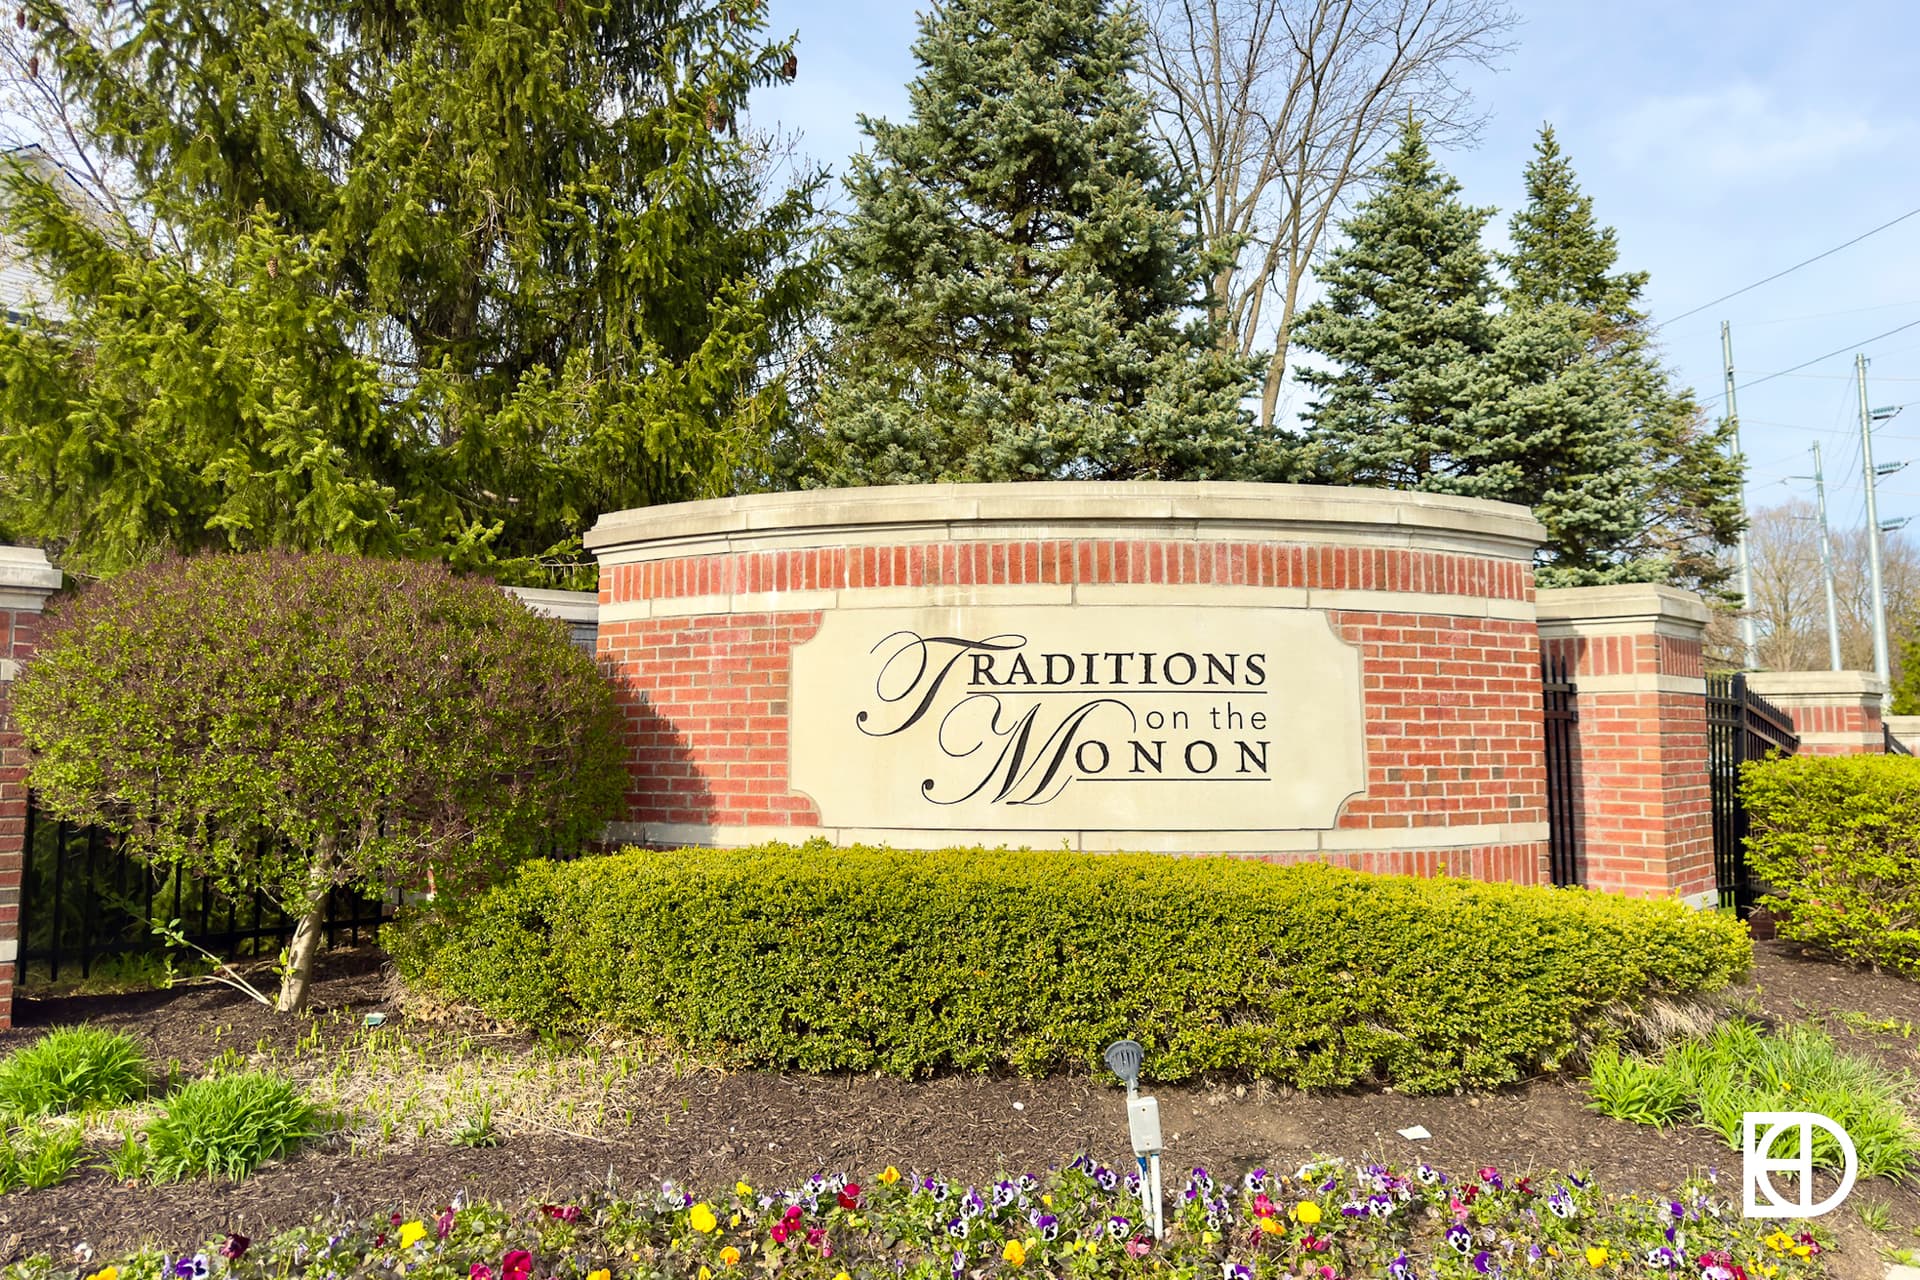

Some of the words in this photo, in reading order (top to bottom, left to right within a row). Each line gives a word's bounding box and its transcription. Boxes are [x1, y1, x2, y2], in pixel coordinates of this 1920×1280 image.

[856, 631, 1268, 736] TRADITIONS
[1147, 709, 1189, 730] on
[1210, 701, 1268, 730] the
[921, 694, 1271, 806] MONON
